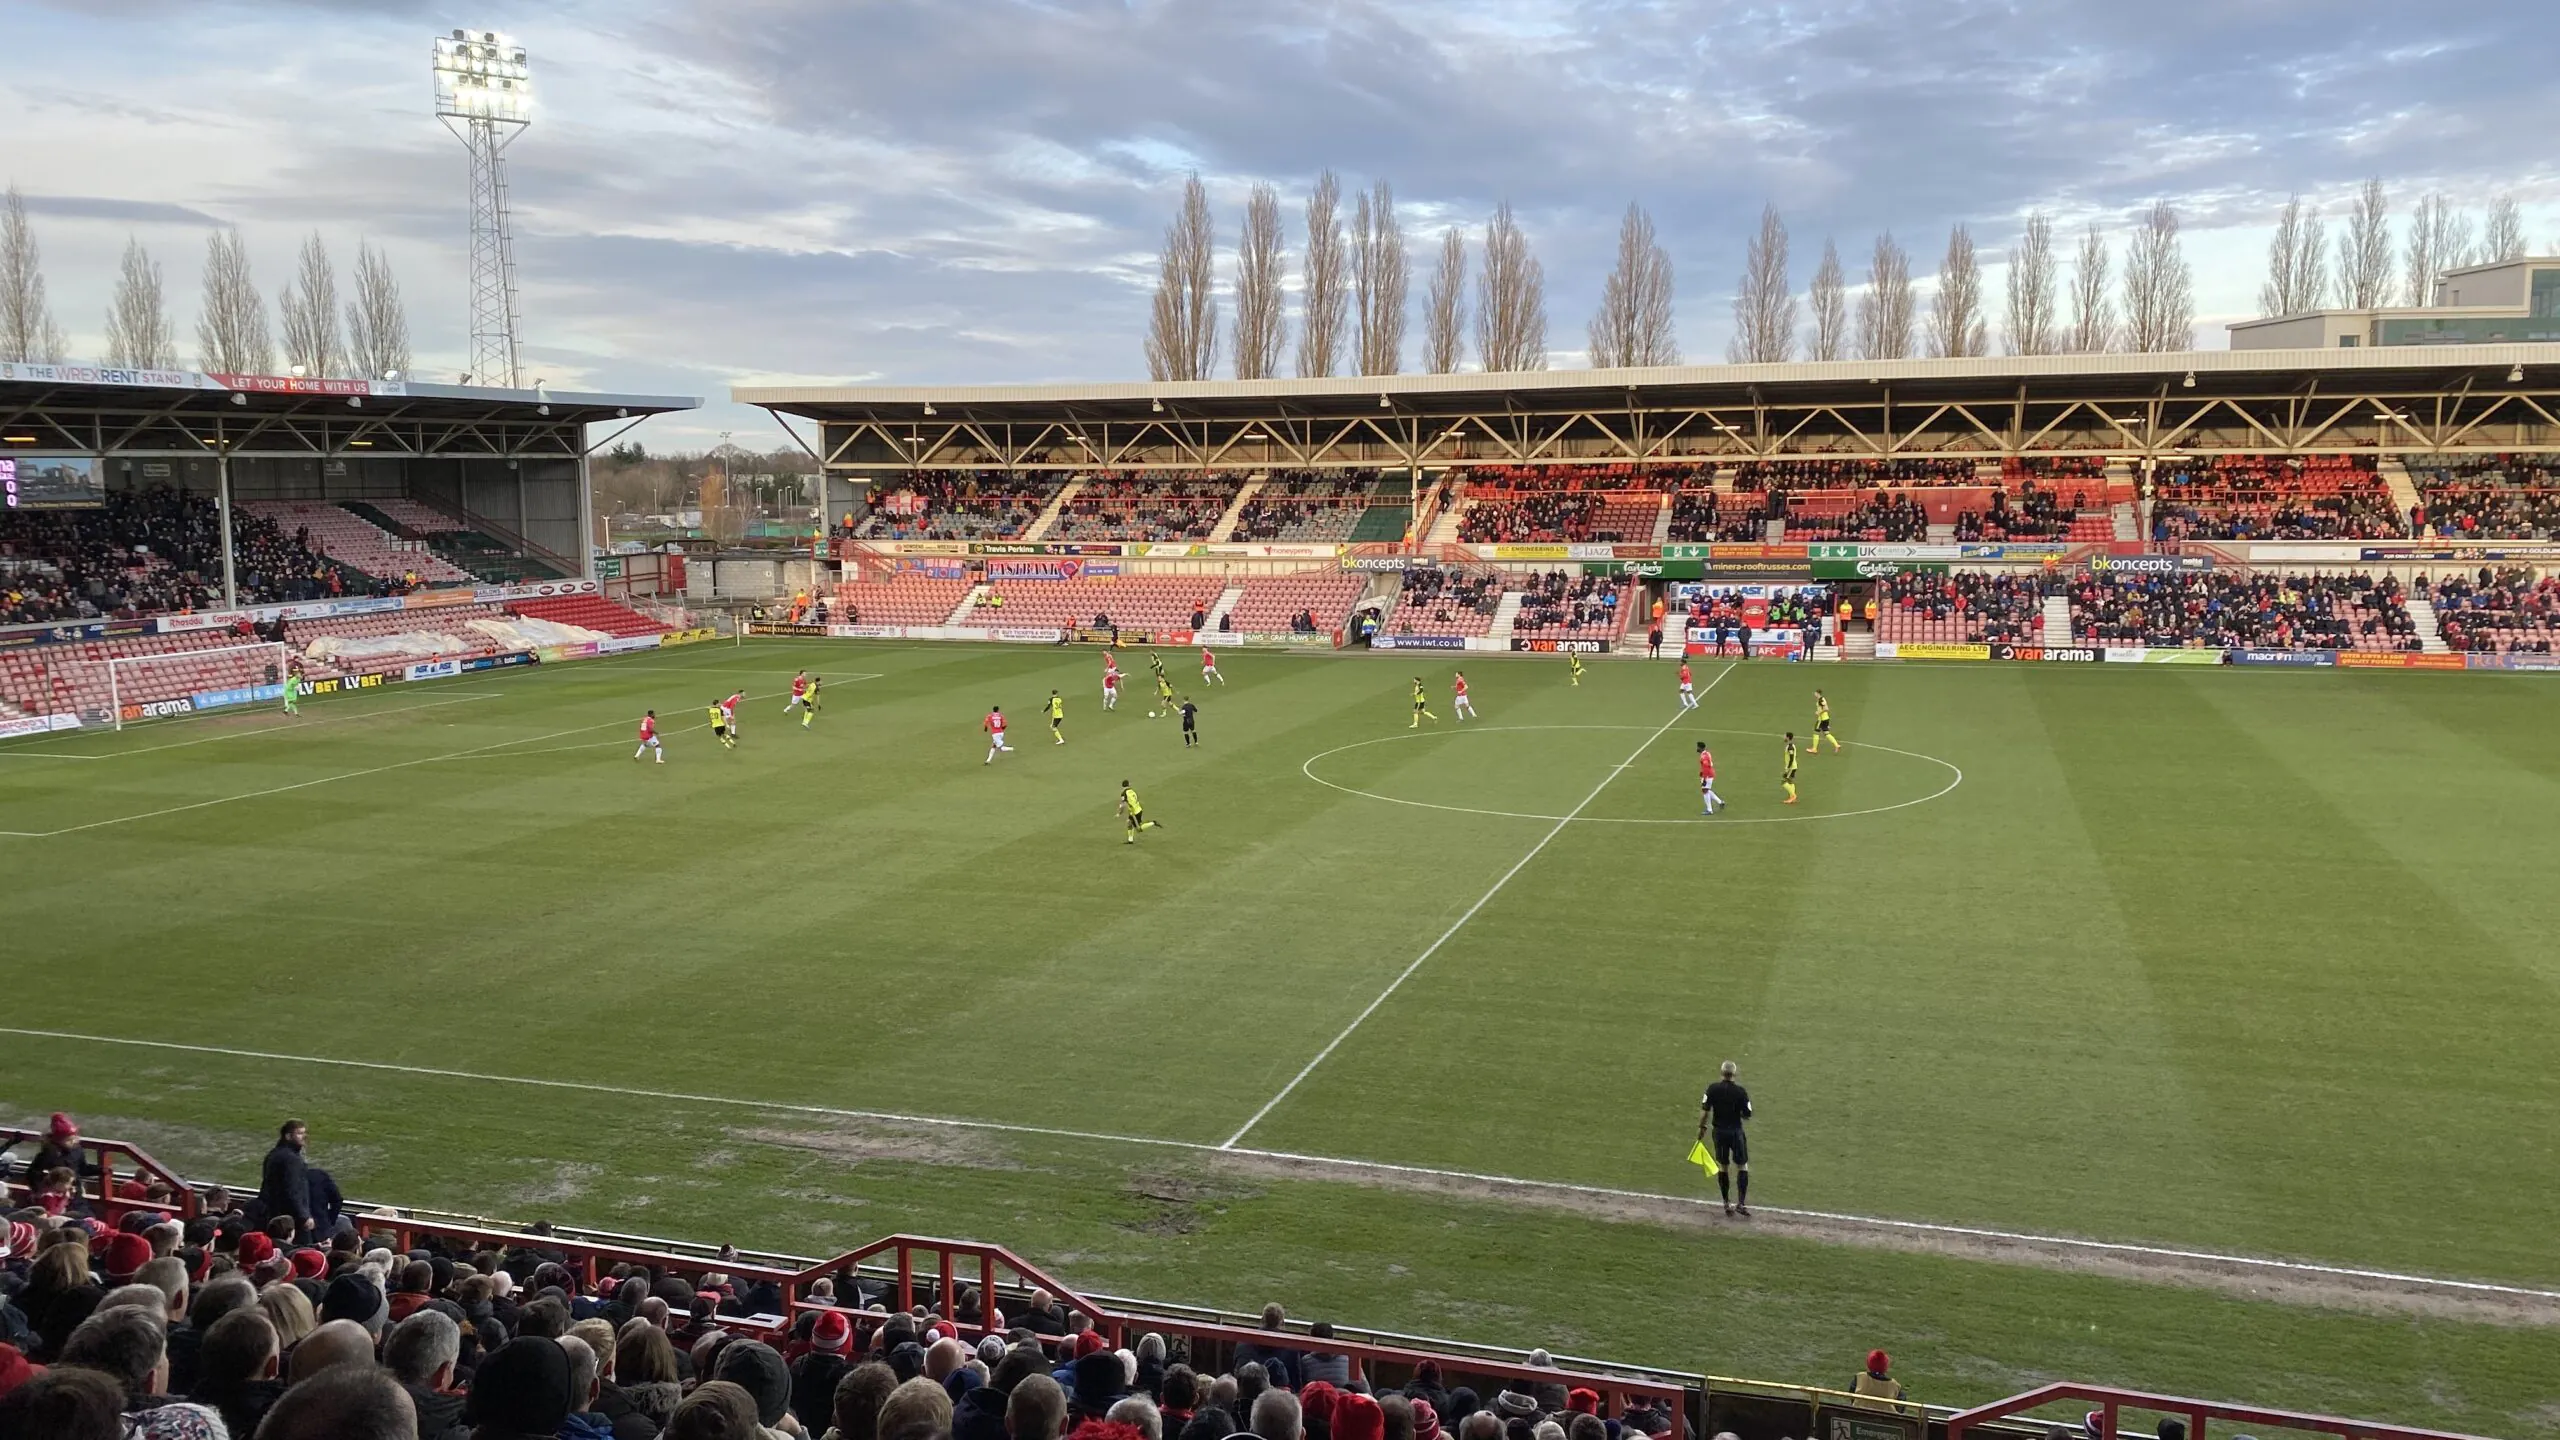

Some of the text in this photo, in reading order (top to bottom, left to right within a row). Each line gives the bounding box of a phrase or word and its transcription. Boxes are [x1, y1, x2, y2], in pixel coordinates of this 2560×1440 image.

[26, 366, 53, 379] THE
[143, 372, 182, 385] STAND
[232, 377, 251, 389] LET
[257, 378, 286, 390] YOUR
[290, 379, 320, 391] HOME
[324, 381, 350, 392] WITH
[353, 382, 367, 393] US
[985, 545, 1035, 553] Travis Perkins
[1588, 547, 1611, 556] JAZZ
[1341, 554, 1405, 571] bkoncepts
[1623, 560, 1664, 573] Carlsberg
[1712, 562, 1811, 571] minera-rooftrusses.com
[2092, 554, 2173, 572] bkoncepts
[169, 616, 204, 628] Rhosddu
[756, 625, 819, 634] WREXHAM LAGER
[1244, 633, 1332, 642] HUWS GRAY HUWS GRAY
[1396, 637, 1464, 648] www.iwt.co.uk
[1532, 639, 1599, 652] vanarama
[1758, 646, 1777, 656] AFC
[1916, 644, 1972, 652] ENGINEERING
[2015, 647, 2094, 661] vanarama
[120, 697, 193, 720] anarama
